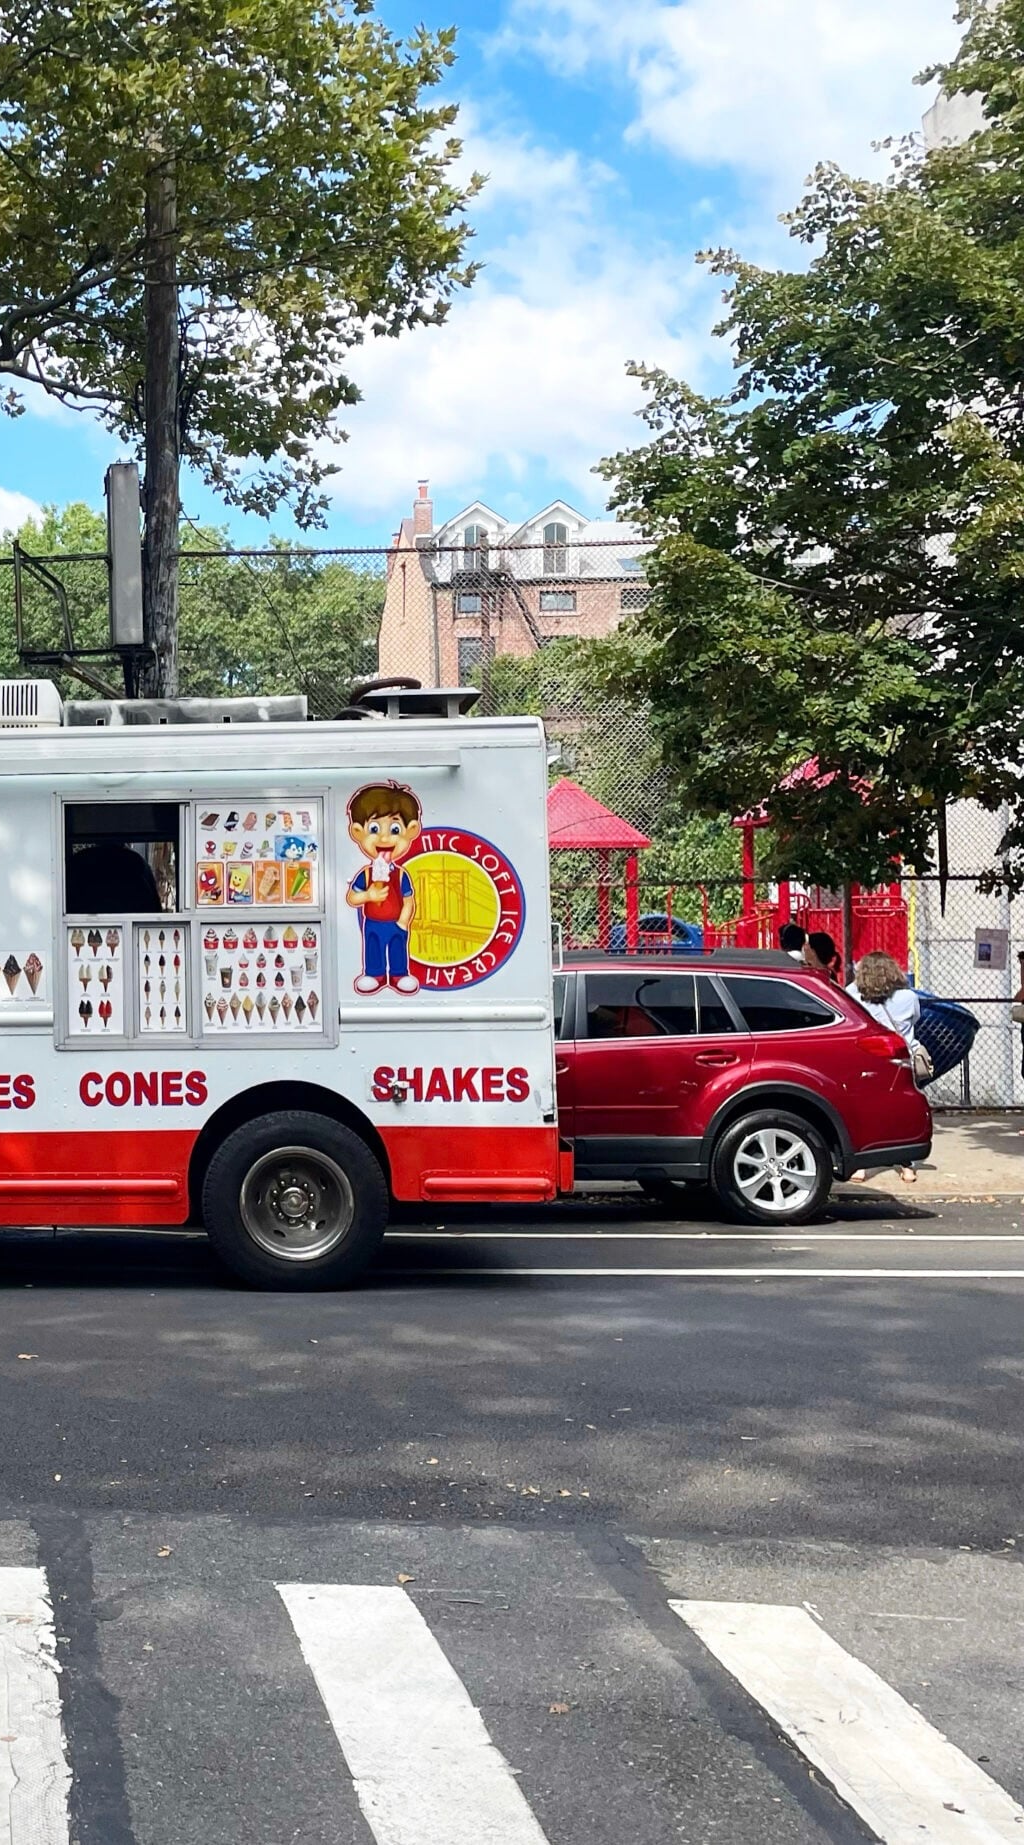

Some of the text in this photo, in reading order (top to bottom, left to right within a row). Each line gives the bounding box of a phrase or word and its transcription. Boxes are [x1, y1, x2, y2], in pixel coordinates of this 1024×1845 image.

[421, 834, 460, 852] NYC
[470, 845, 516, 895] SOFT
[495, 911, 519, 945] ICE
[425, 951, 497, 986] CREAM
[79, 1071, 208, 1107] CONES
[372, 1066, 531, 1103] SHAKES
